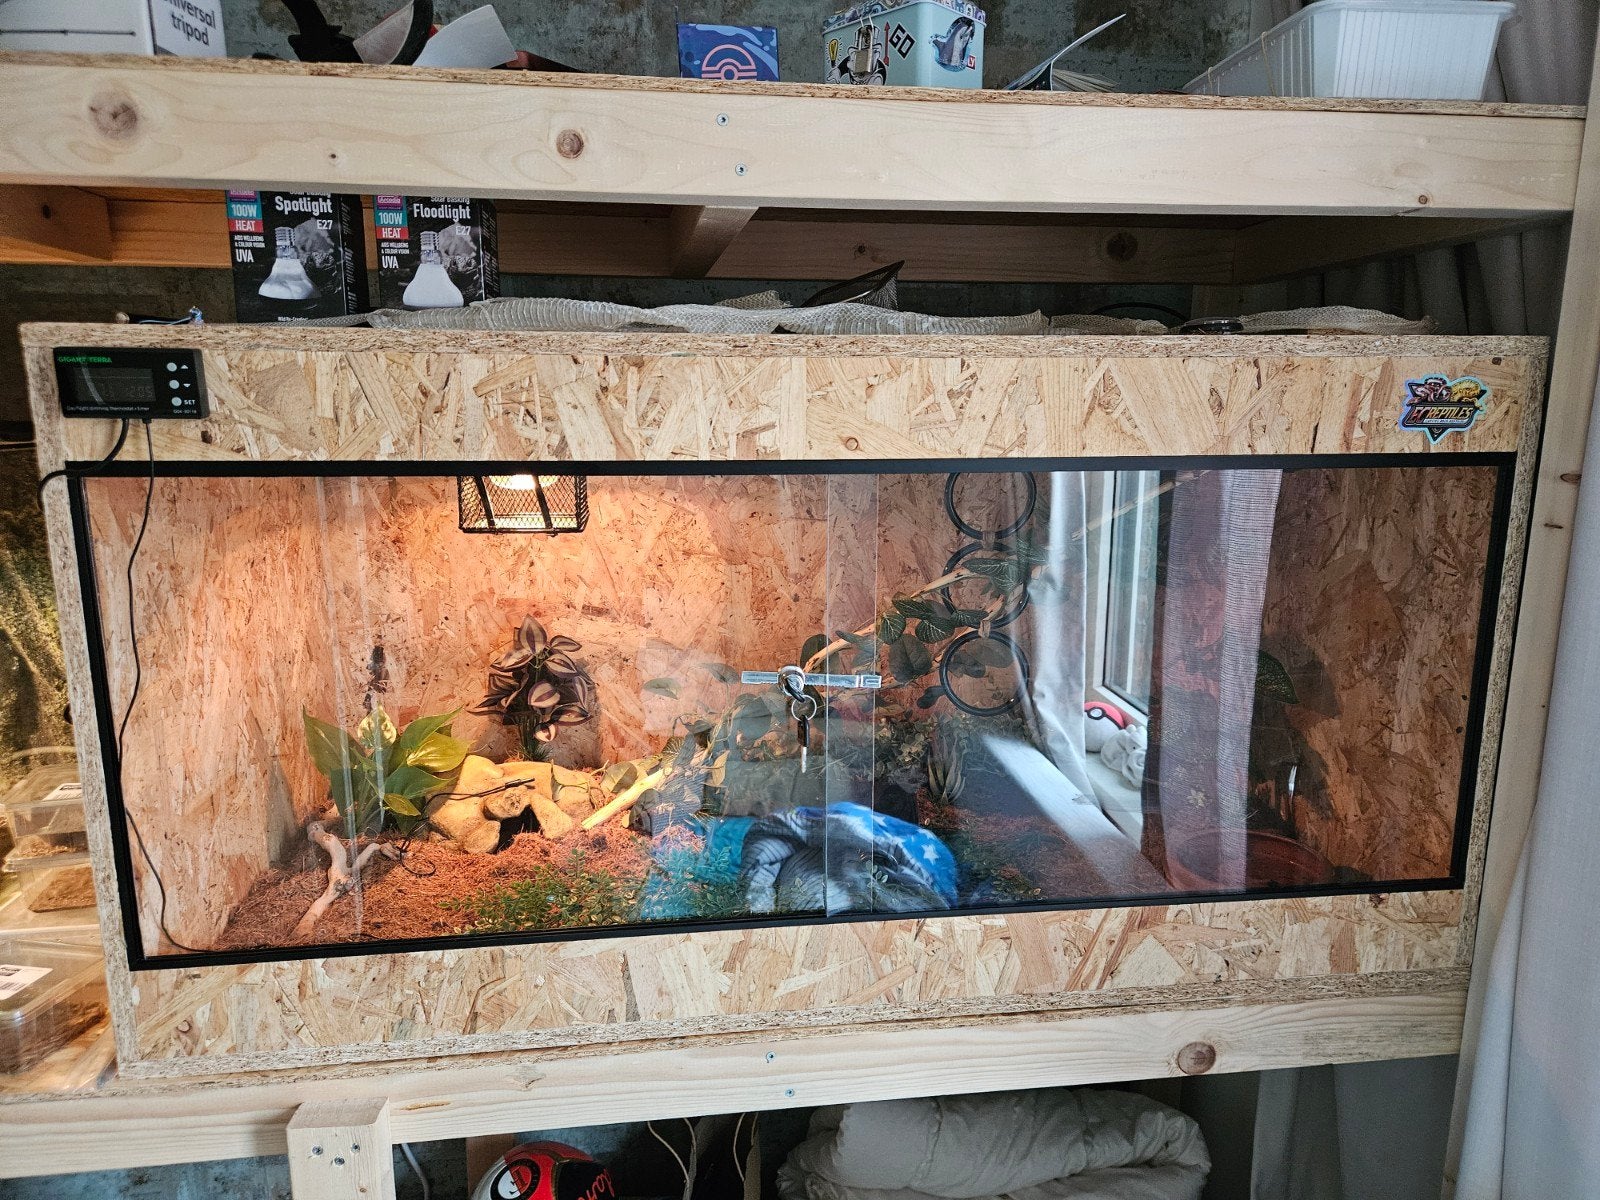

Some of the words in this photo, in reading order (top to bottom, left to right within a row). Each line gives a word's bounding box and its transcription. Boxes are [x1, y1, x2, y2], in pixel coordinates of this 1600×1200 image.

[164, 0, 216, 29] niversal
[171, 11, 209, 46] tripod
[889, 23, 915, 59] GO
[231, 203, 258, 218] 100W
[274, 195, 333, 216] Spotlight
[378, 211, 403, 225] 100W
[413, 203, 471, 223] Floodlight
[235, 219, 256, 232] HEAT
[316, 219, 333, 231] E27
[455, 225, 471, 236] E27
[382, 227, 401, 239] HEAT
[235, 249, 254, 263] UVA
[381, 255, 399, 269] UVA
